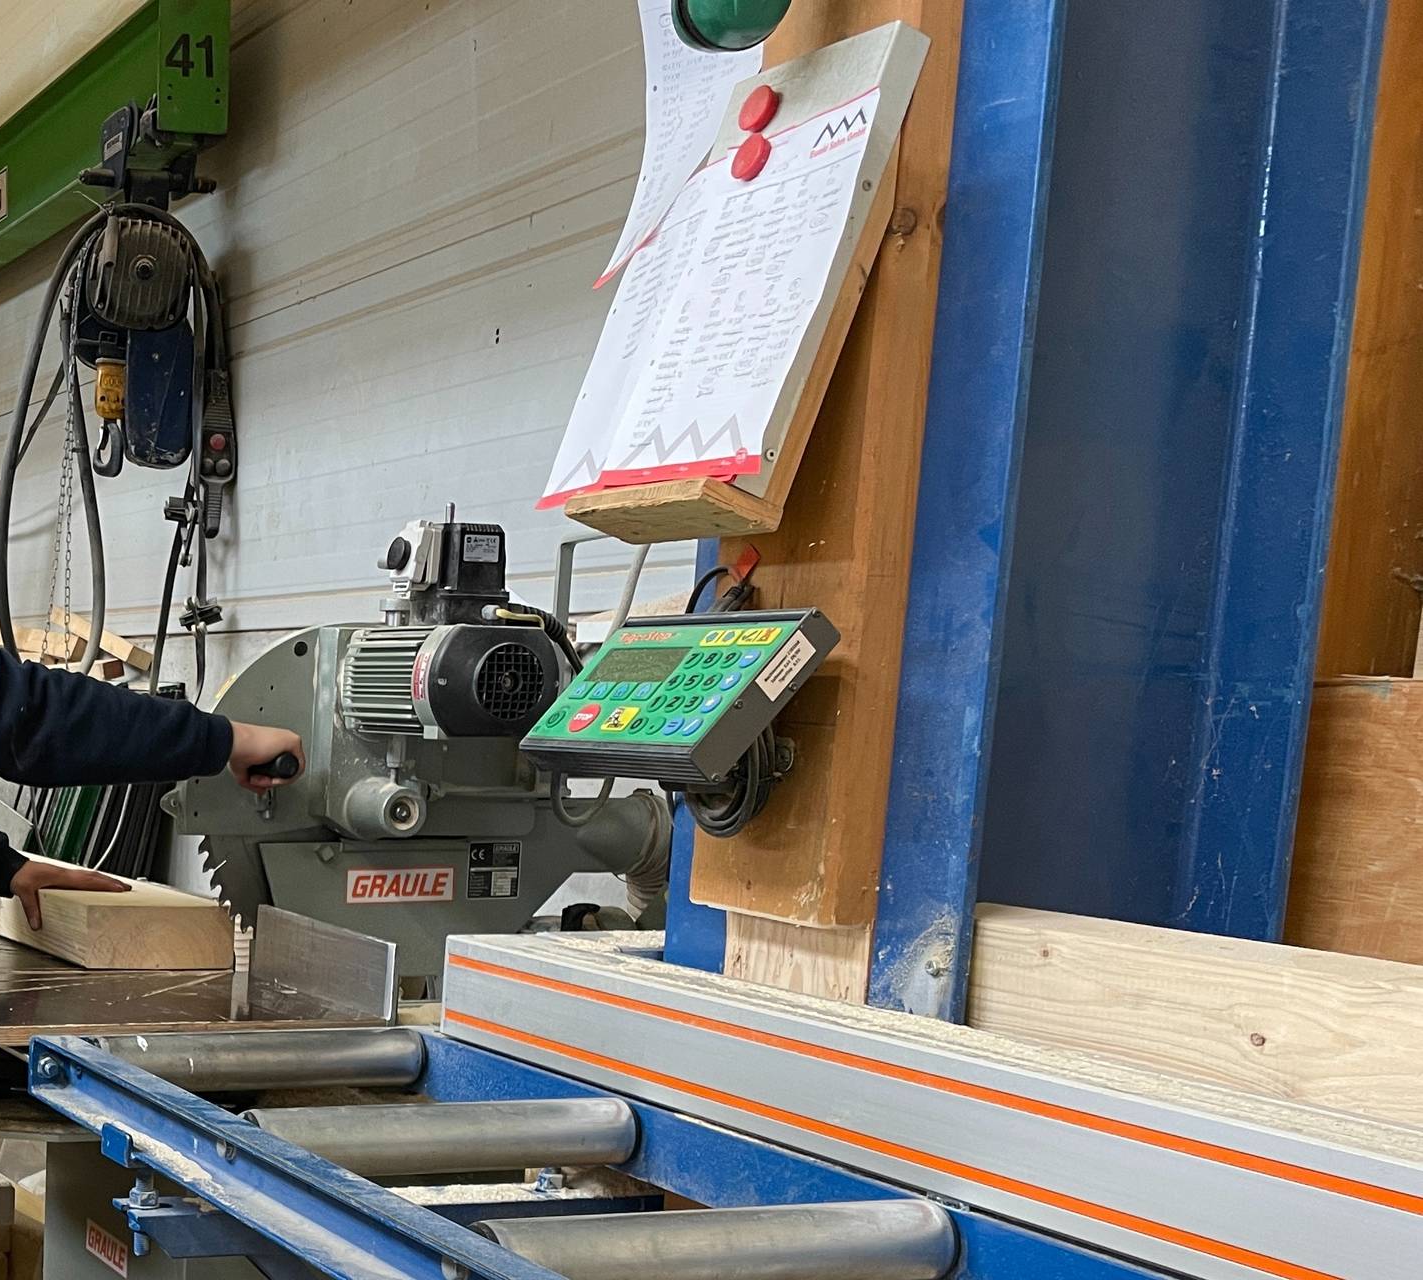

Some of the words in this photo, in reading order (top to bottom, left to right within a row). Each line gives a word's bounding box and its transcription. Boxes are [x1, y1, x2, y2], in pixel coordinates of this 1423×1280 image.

[165, 33, 214, 78] 41
[685, 652, 699, 664] 7
[703, 652, 718, 664] 8
[722, 652, 737, 664] 9
[668, 675, 680, 686] 4
[684, 675, 699, 686] 5
[703, 674, 717, 686] 6
[650, 696, 661, 708] 1
[665, 696, 681, 707] 2
[684, 696, 699, 708] 3
[573, 713, 594, 721] STOP
[630, 718, 643, 730] 0
[351, 872, 449, 898] GRAULE
[88, 1225, 126, 1270] GRAULE
